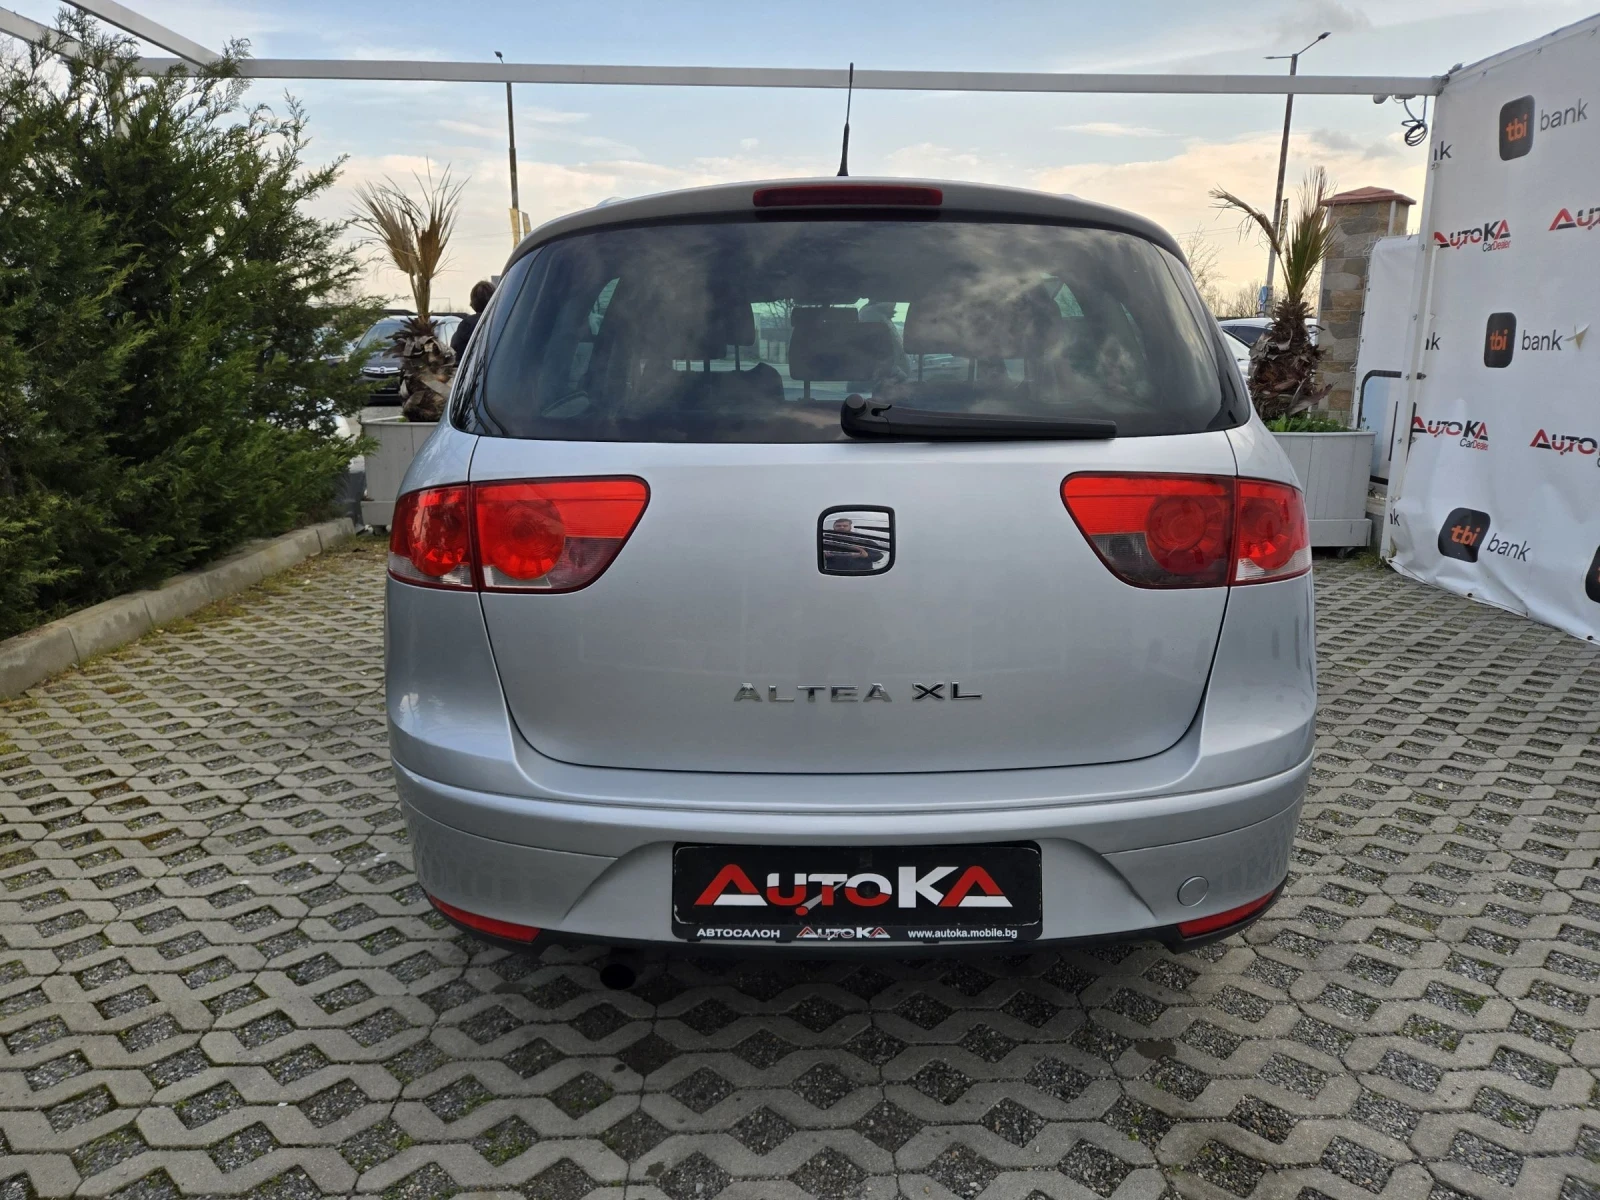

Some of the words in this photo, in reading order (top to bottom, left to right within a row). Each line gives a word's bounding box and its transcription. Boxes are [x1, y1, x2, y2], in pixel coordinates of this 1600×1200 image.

[1505, 113, 1528, 142] tbi
[1540, 98, 1589, 132] bank
[1489, 329, 1508, 351] tbi
[1521, 329, 1563, 351] bank
[1451, 524, 1481, 547] tbi
[1486, 533, 1531, 562] bank
[734, 682, 893, 702] ALTEA
[912, 681, 983, 700] XL
[693, 864, 1014, 916] AUTOKA
[696, 928, 781, 939] АВТОСАЛОН
[907, 928, 1018, 939] www.autoka.mobile.bg
